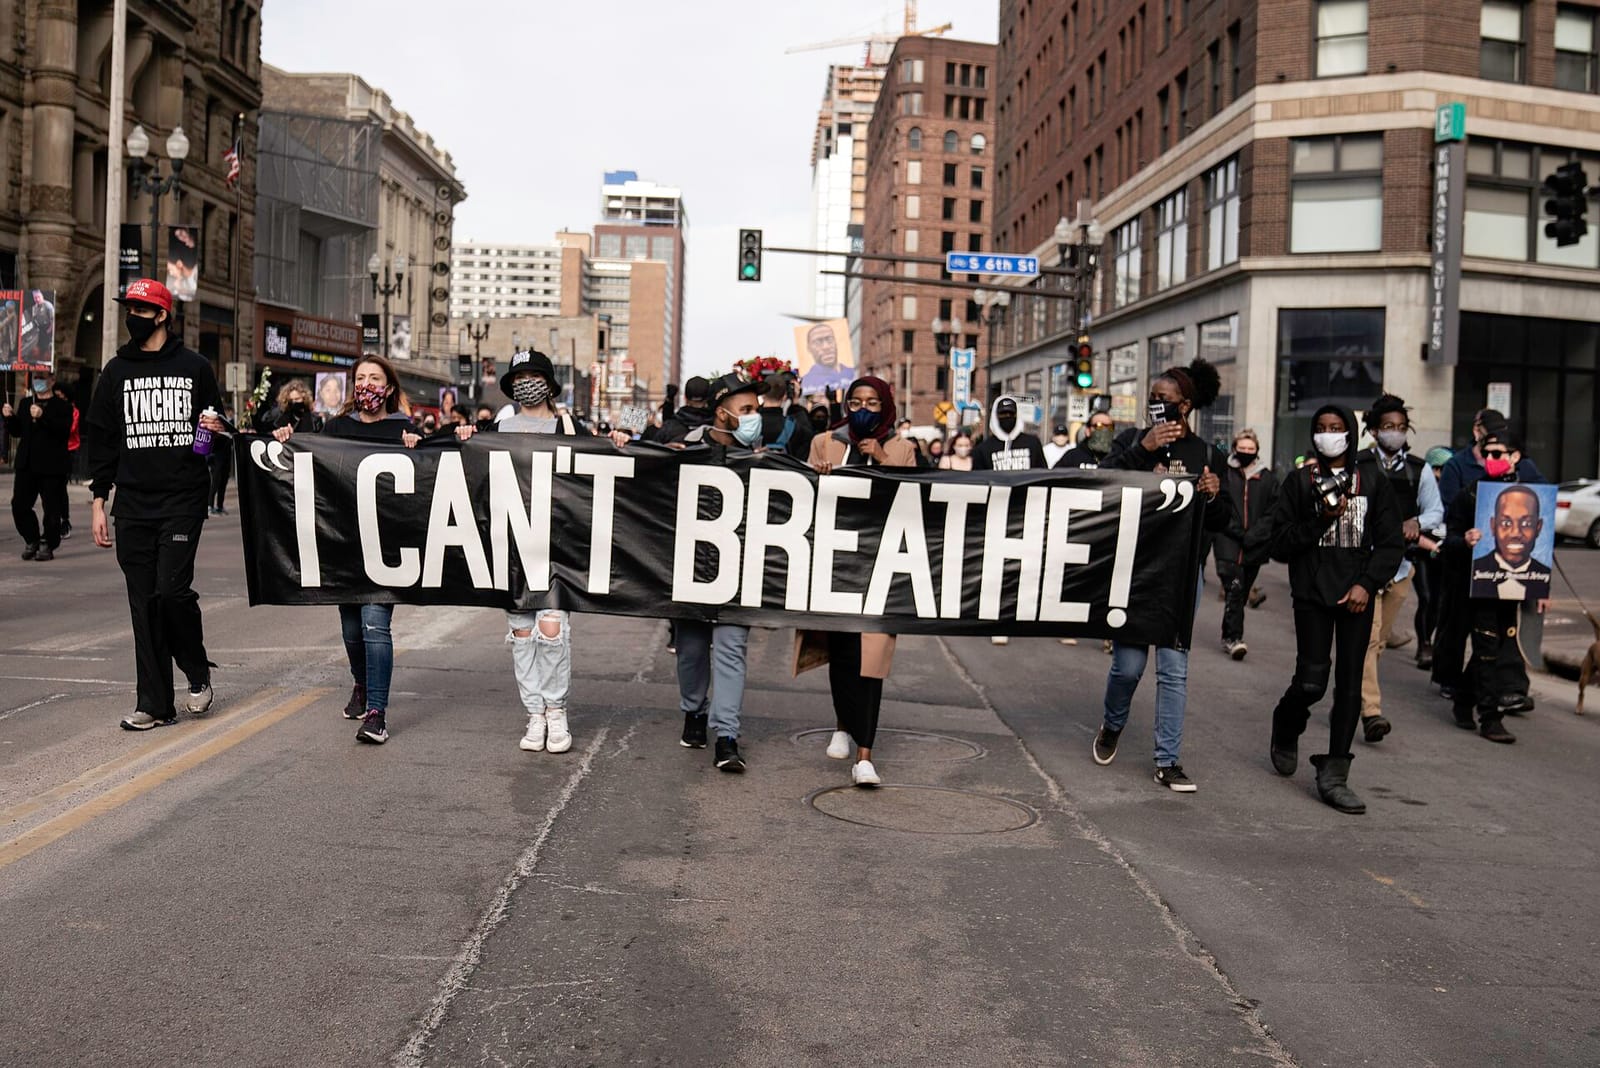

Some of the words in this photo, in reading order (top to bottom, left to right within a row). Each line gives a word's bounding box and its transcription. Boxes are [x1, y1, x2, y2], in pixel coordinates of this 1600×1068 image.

[1438, 108, 1451, 136] E
[1436, 148, 1450, 254] EMBASSY
[968, 256, 980, 270] S
[984, 257, 1013, 272] 6th
[1017, 258, 1035, 273] St
[1431, 260, 1445, 351] SUITES
[123, 379, 132, 391] A
[134, 377, 161, 390] MAN
[163, 376, 193, 390] WAS
[123, 389, 192, 424] LYNCHED
[126, 423, 135, 436] IN
[135, 421, 193, 435] MINNEAPOLIS
[127, 437, 139, 449] ON
[139, 435, 157, 448] MAY
[158, 434, 172, 447] 25,
[173, 433, 194, 447] 2020
[356, 445, 635, 594] CAN'T
[1493, 571, 1504, 582] for
